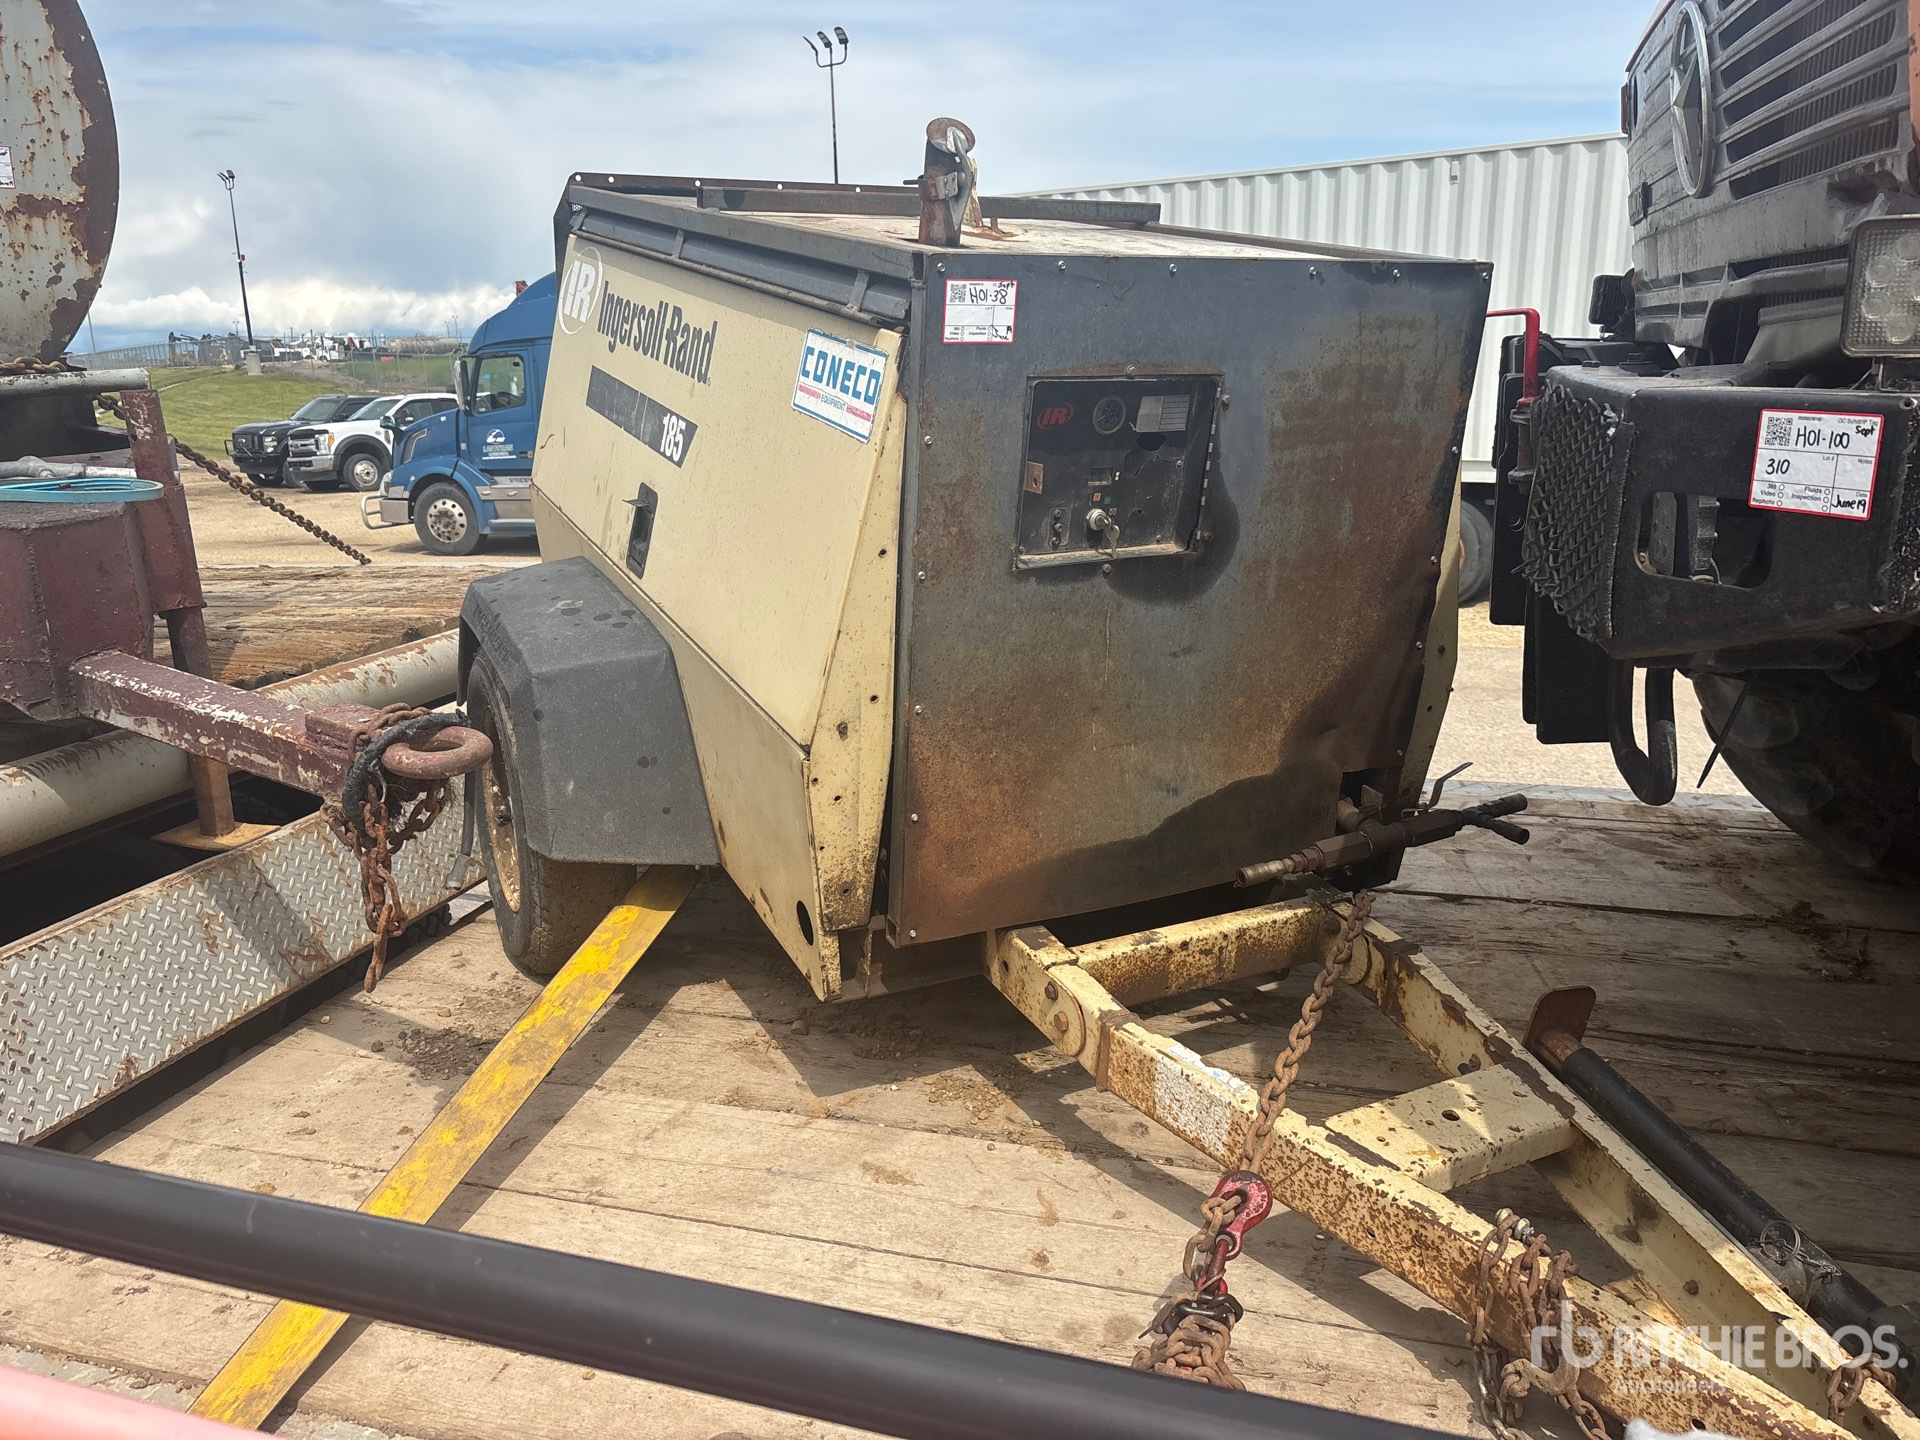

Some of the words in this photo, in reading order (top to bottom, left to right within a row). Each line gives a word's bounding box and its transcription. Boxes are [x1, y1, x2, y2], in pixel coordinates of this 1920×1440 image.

[801, 346, 881, 405] CONECO
[820, 394, 846, 411] EQUIPMENT
[1043, 407, 1069, 424] IR
[660, 412, 687, 462] 185
[1765, 458, 1791, 475] 310
[1791, 493, 1822, 502] Inspection
[1804, 486, 1822, 494] Fluids
[1752, 497, 1775, 505] Rephoto
[1857, 499, 1867, 513] 19
